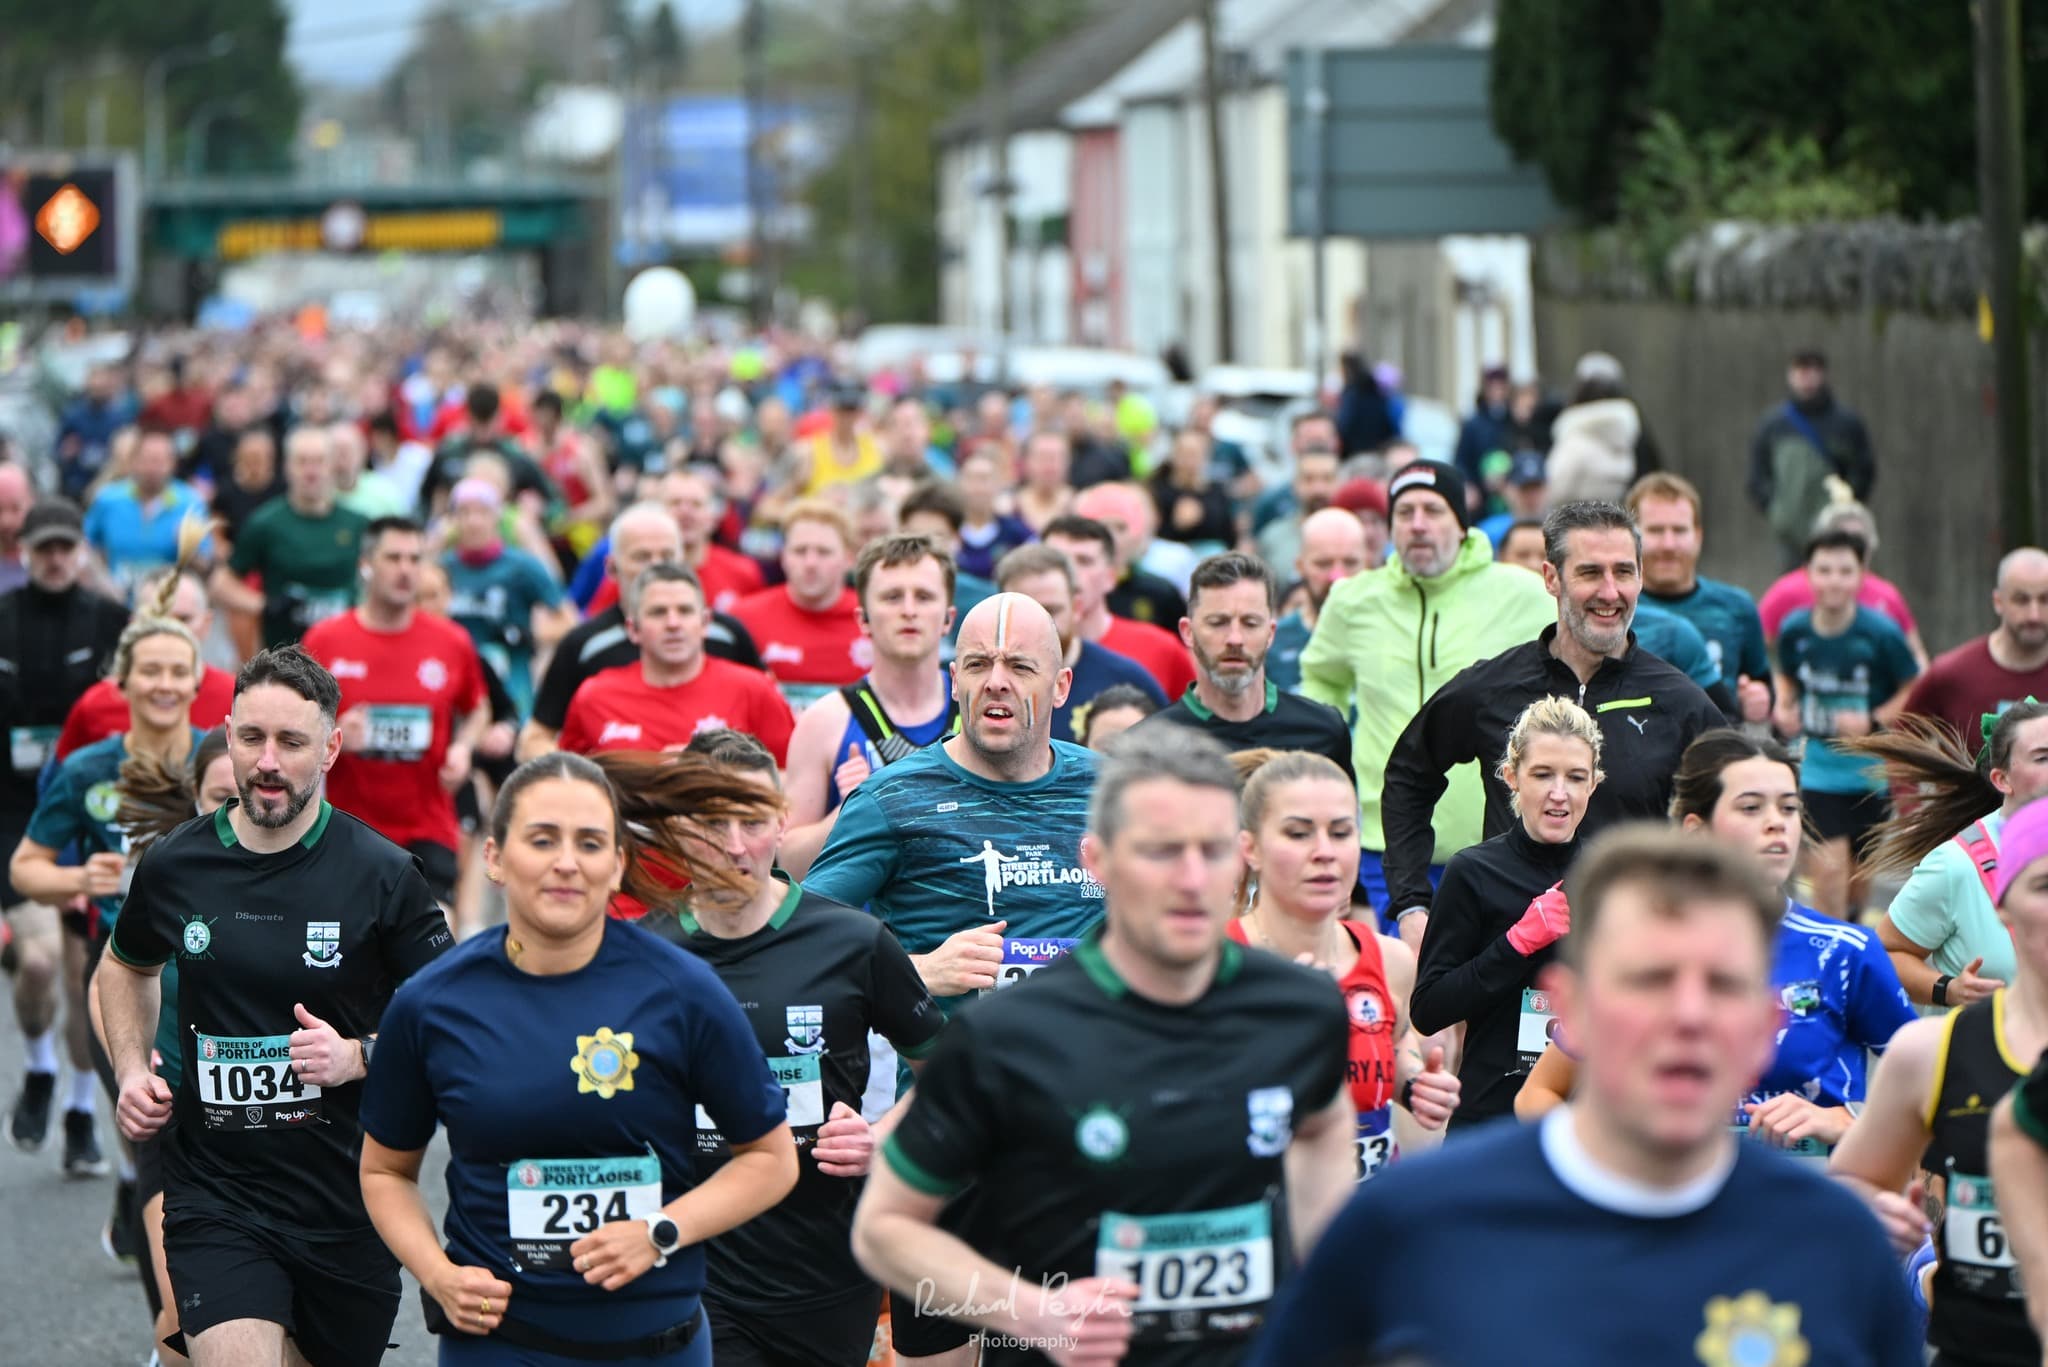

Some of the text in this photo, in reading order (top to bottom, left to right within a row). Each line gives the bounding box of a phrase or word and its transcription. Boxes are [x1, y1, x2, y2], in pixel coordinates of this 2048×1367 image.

[1001, 861, 1053, 871] STREETS OF
[1002, 868, 1103, 887] PORTLAOIS
[1010, 941, 1059, 959] Pop Up
[217, 1041, 249, 1049] STREETS
[217, 1047, 290, 1059] PORTLAOIS
[208, 1064, 305, 1101] 1034
[275, 1111, 305, 1124] Pop Up
[697, 1141, 719, 1149] PARK
[543, 1170, 643, 1186] PORTLAOISE
[542, 1190, 631, 1234] 234
[516, 1243, 562, 1251] MIDLANDS
[527, 1252, 550, 1260] PARK
[1123, 1251, 1250, 1300] 1023
